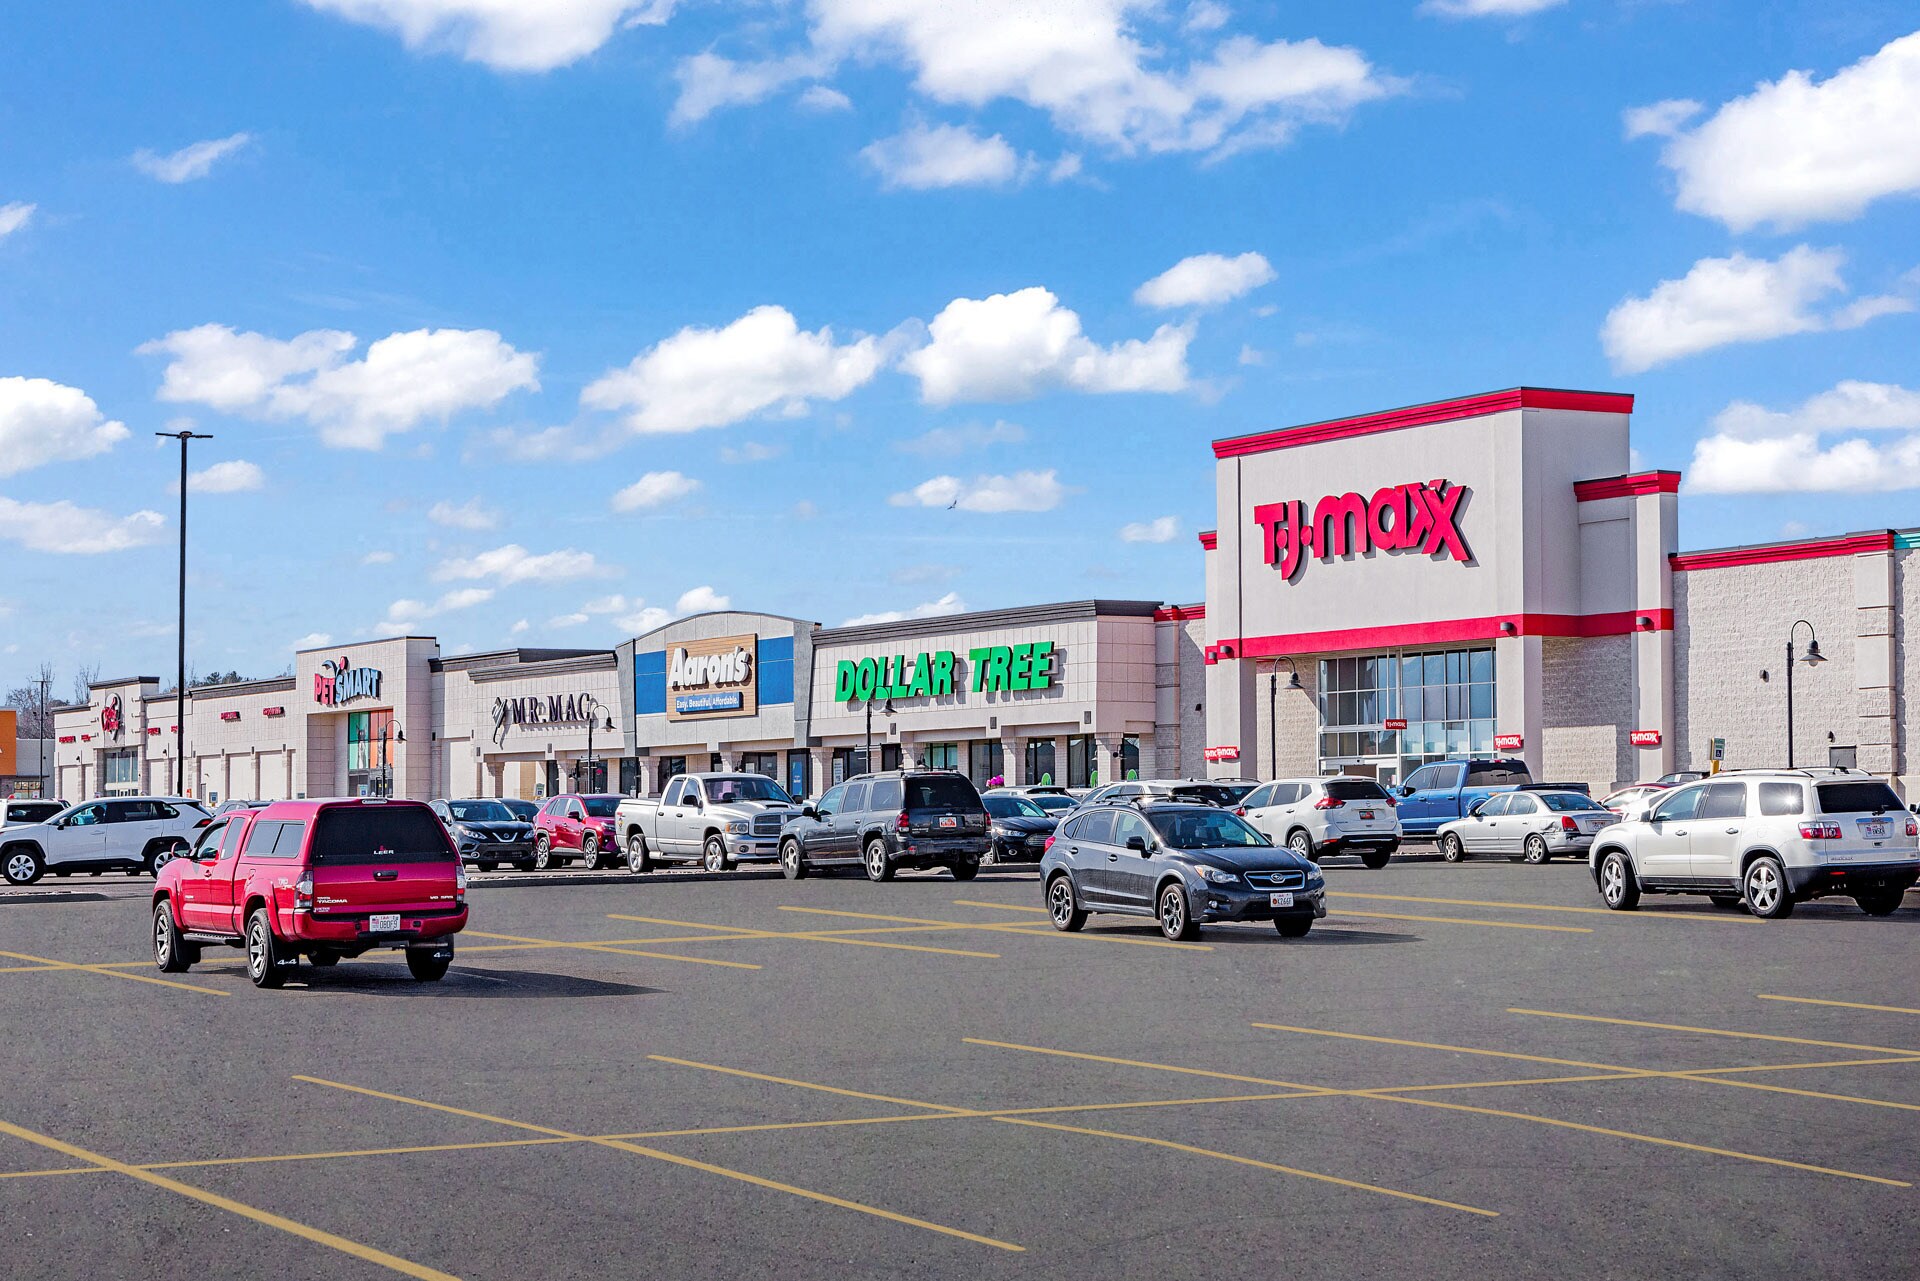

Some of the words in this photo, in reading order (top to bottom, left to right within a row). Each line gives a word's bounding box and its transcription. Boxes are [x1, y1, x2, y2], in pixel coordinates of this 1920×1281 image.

[667, 646, 750, 686] Aaron's
[835, 651, 954, 702] DOLLAR
[969, 641, 1054, 692] TREE
[314, 667, 381, 705] PETSMART
[511, 697, 546, 724] MR.
[547, 693, 590, 722] MAC
